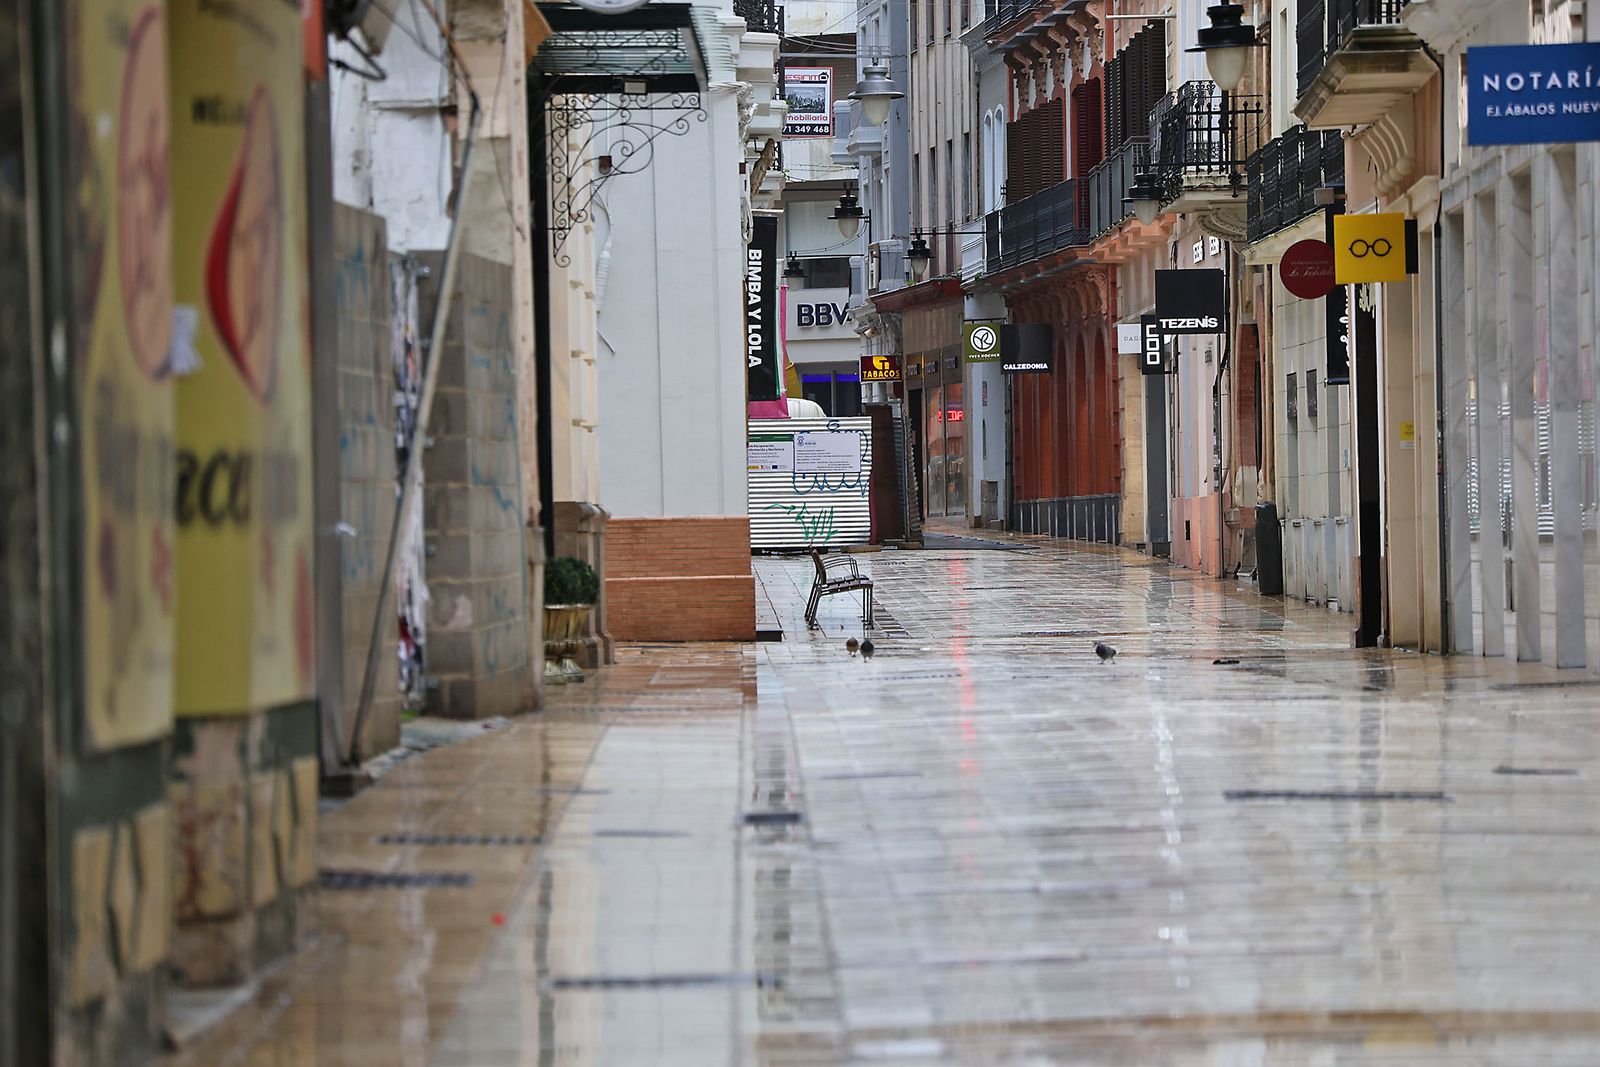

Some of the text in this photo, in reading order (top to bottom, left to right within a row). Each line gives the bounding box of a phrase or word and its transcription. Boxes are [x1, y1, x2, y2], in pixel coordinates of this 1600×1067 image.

[1483, 65, 1600, 92] NOTARÍ
[1505, 102, 1555, 116] ÁBALOS
[1562, 101, 1600, 114] NUEV
[782, 125, 829, 133] 71 349 468
[748, 249, 763, 368] BIMBA Y LOLA
[1003, 362, 1048, 371] CALZEDONIA
[863, 370, 900, 379] TABACOS
